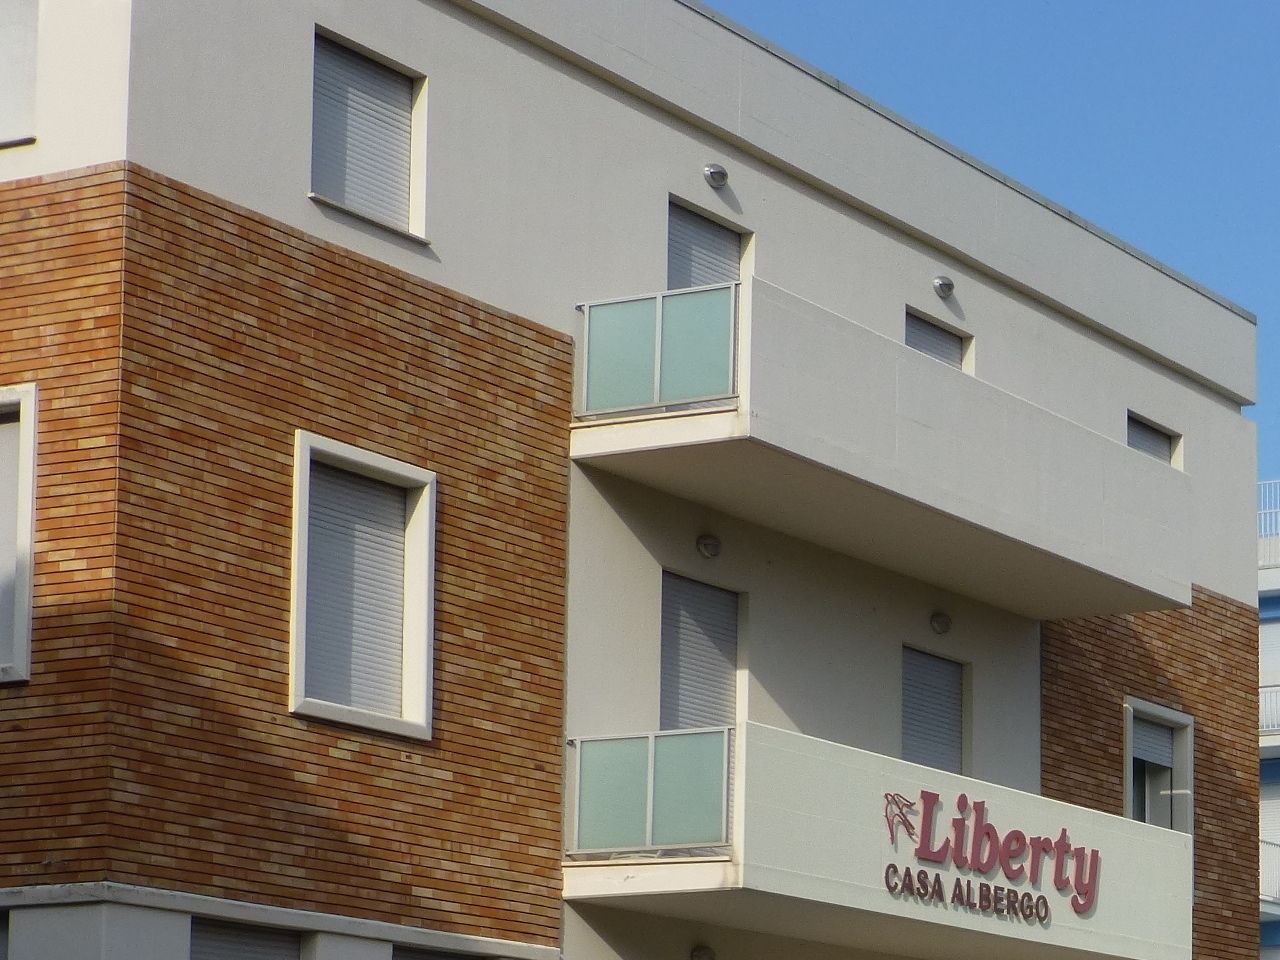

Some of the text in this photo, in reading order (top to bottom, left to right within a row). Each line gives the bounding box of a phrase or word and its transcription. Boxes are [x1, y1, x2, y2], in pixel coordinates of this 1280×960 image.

[884, 863, 1049, 923] CASA ALBERGO
[914, 790, 1099, 913] Liberty
